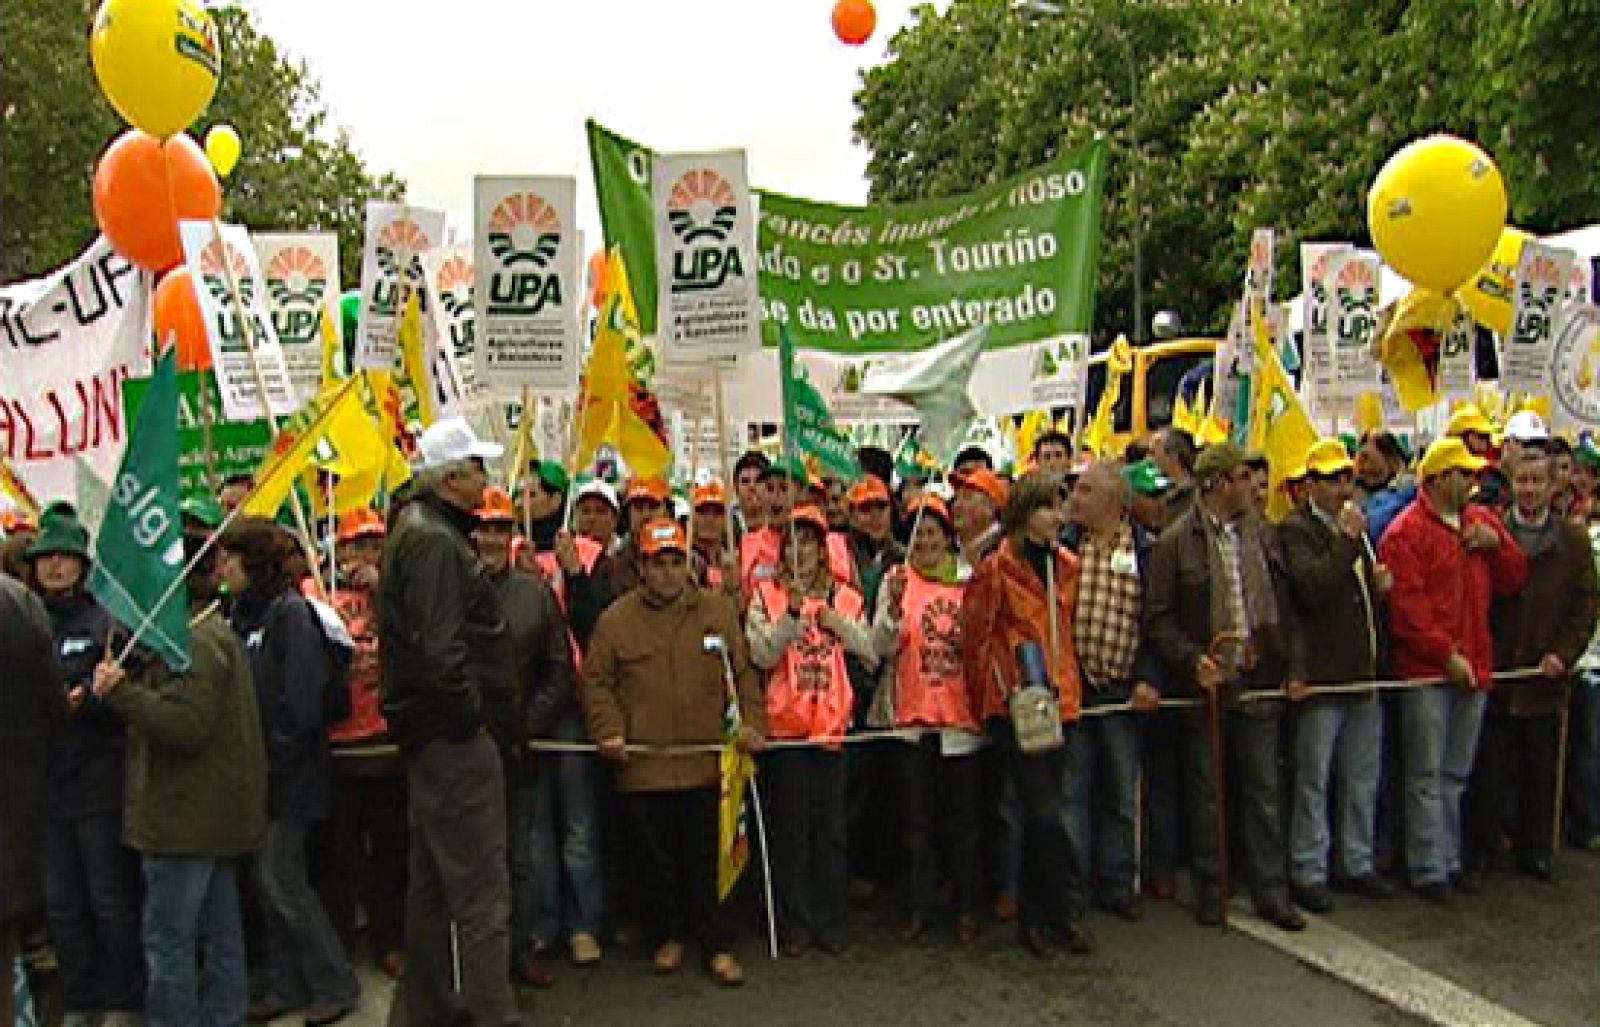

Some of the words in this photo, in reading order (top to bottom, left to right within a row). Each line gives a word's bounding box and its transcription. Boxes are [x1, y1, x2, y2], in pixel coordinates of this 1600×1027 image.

[672, 246, 744, 294] UPA
[928, 229, 1057, 276] Touriño
[485, 273, 562, 315] UPA
[797, 296, 836, 331] da
[845, 306, 901, 341] por
[911, 284, 1057, 330] enterado
